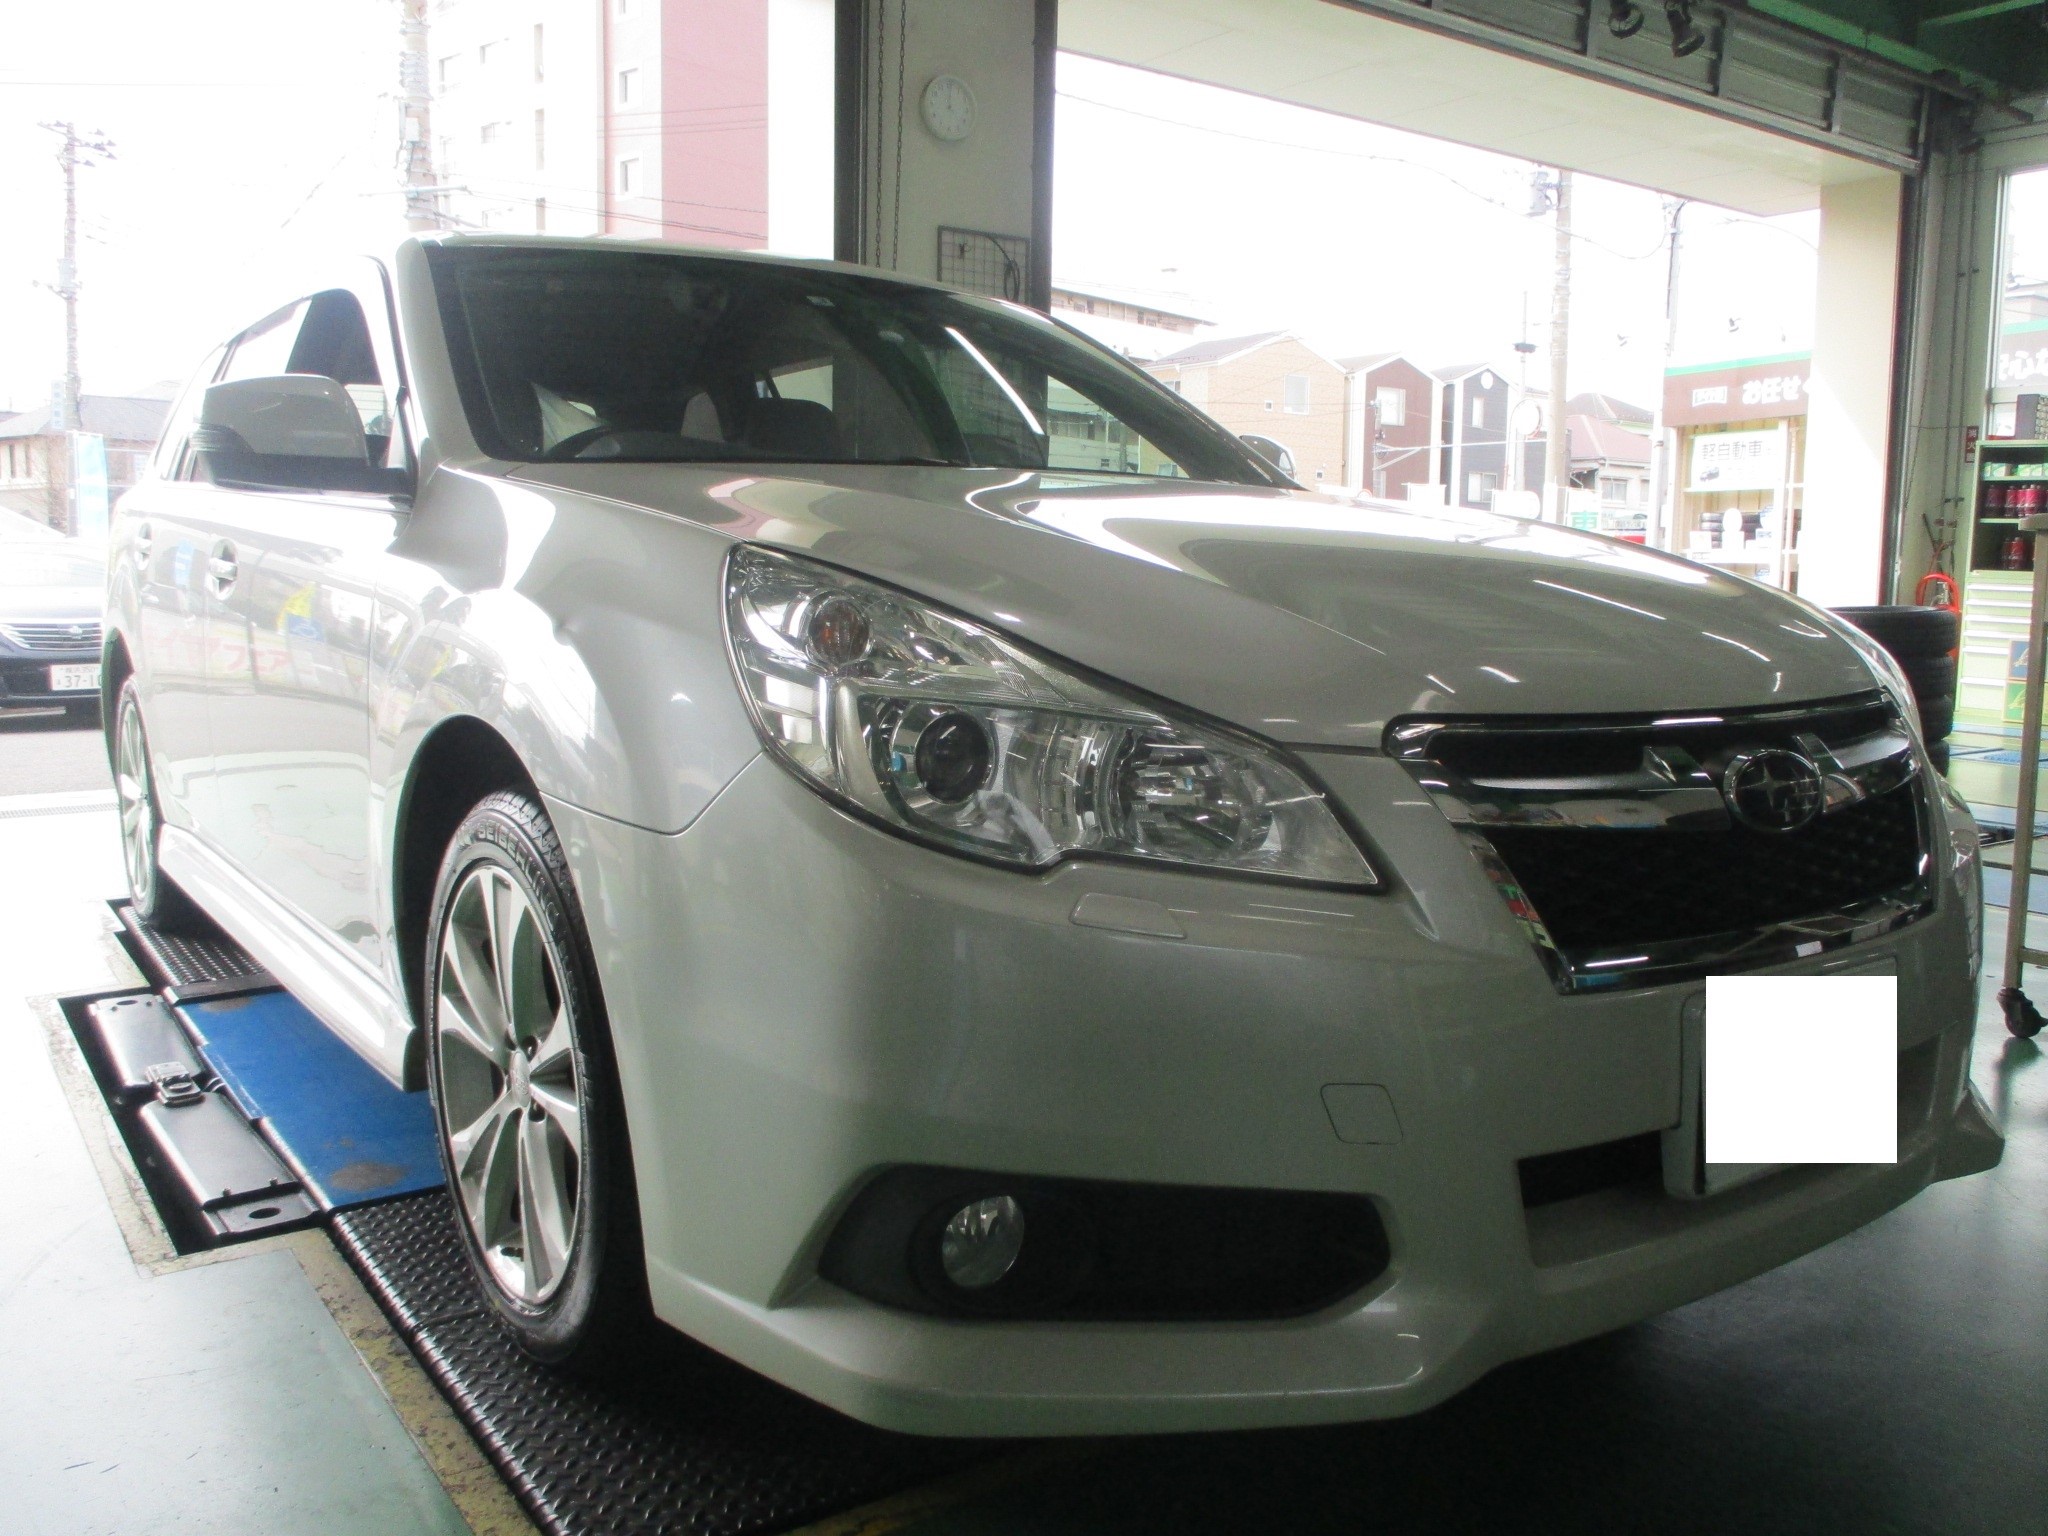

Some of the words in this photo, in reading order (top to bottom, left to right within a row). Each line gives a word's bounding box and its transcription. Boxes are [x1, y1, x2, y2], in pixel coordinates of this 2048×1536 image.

[1742, 376, 1809, 404] お任せ
[1702, 440, 1763, 461] 軽自動車
